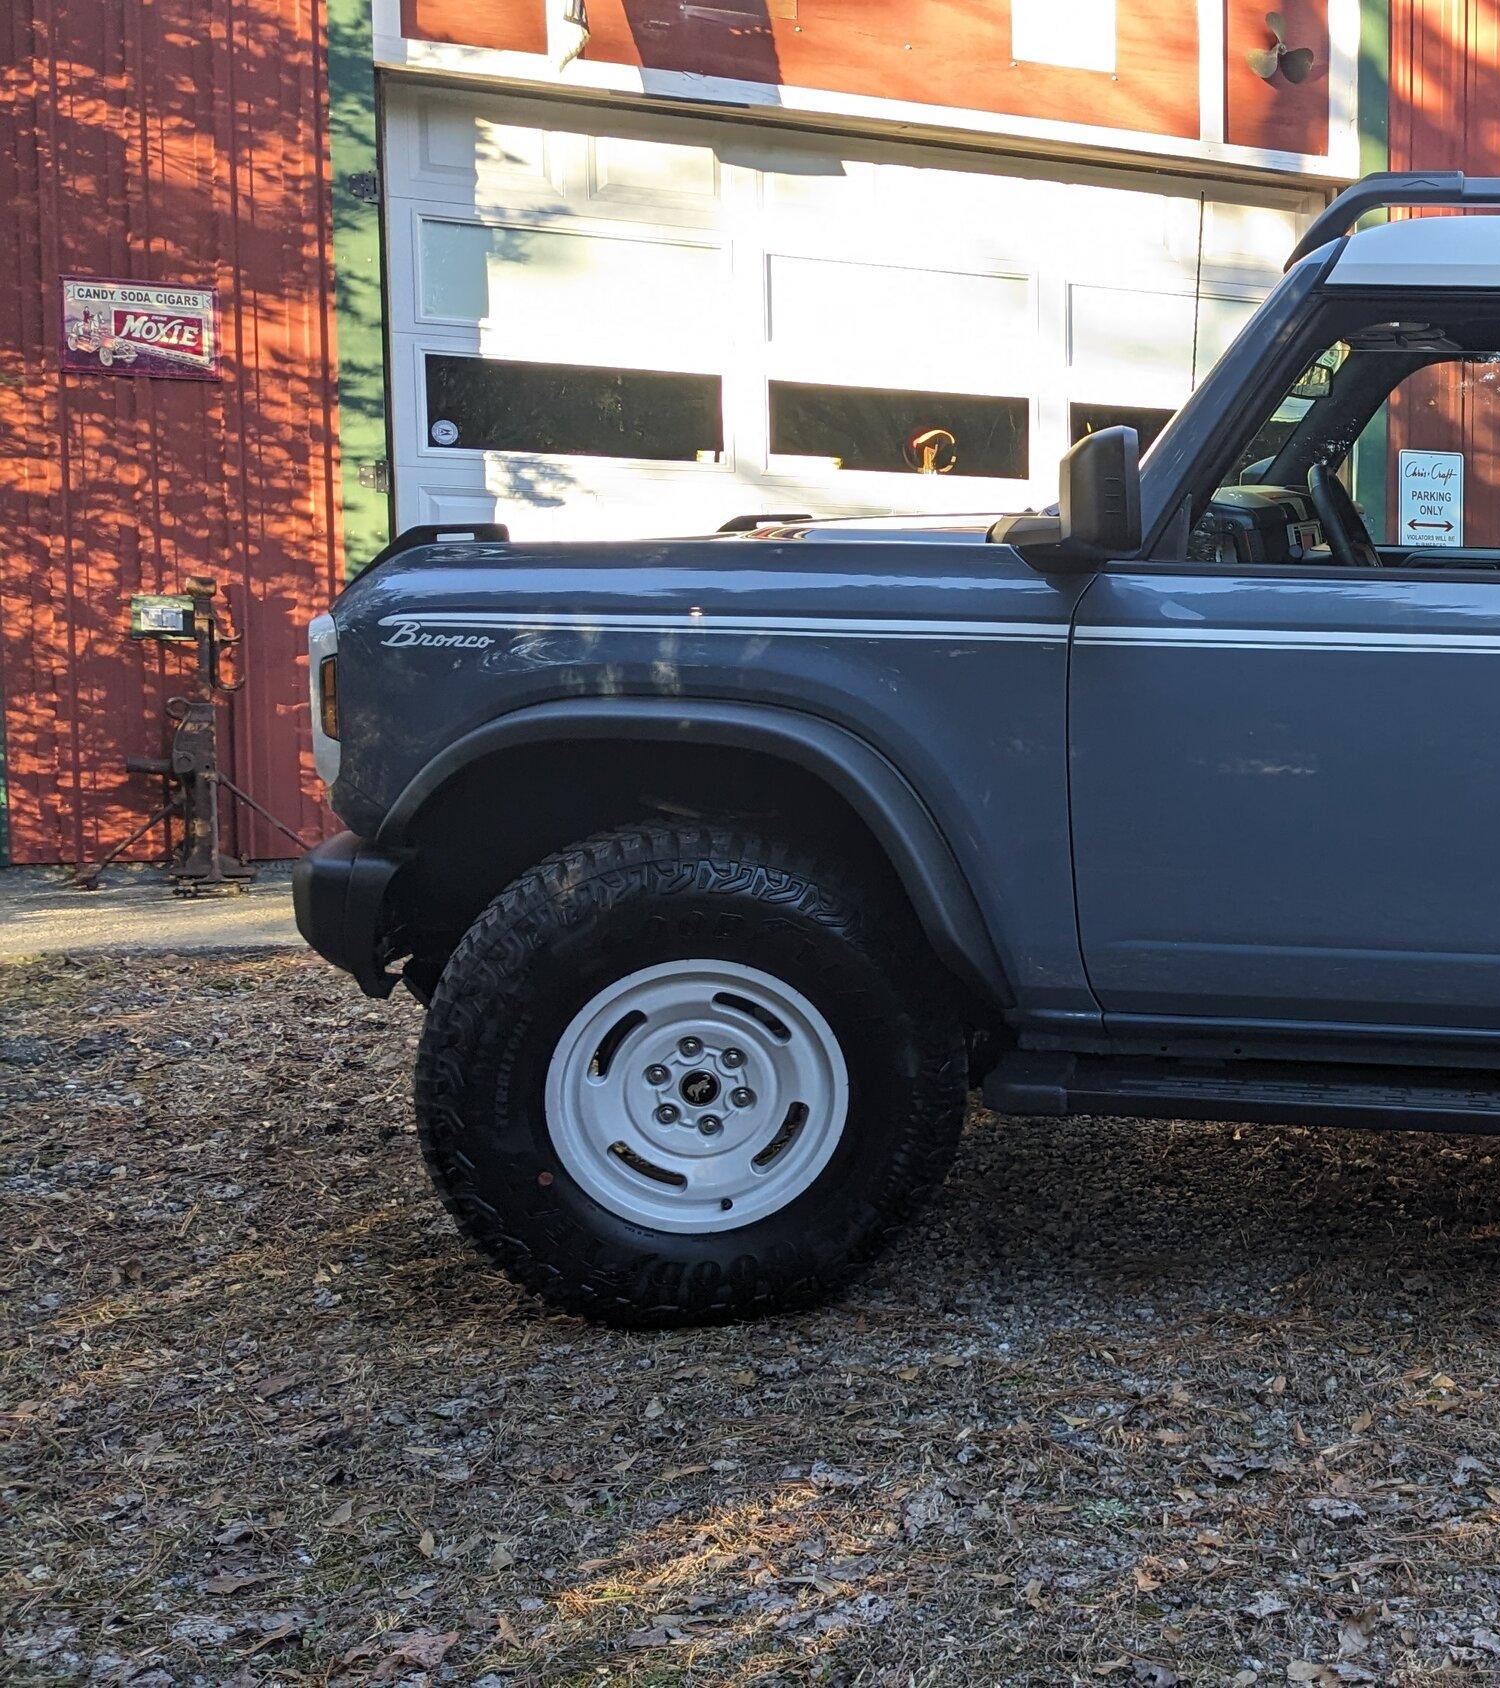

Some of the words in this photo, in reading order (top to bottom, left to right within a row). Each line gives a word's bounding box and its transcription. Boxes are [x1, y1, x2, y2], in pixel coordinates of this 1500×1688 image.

[77, 287, 116, 300] CANDY
[120, 290, 151, 302] SODA
[155, 293, 199, 306] CIGARS
[119, 314, 199, 347] MOXIE
[1411, 490, 1452, 502] PARKING
[1419, 505, 1444, 516] ONLY
[380, 621, 495, 649] Bronco
